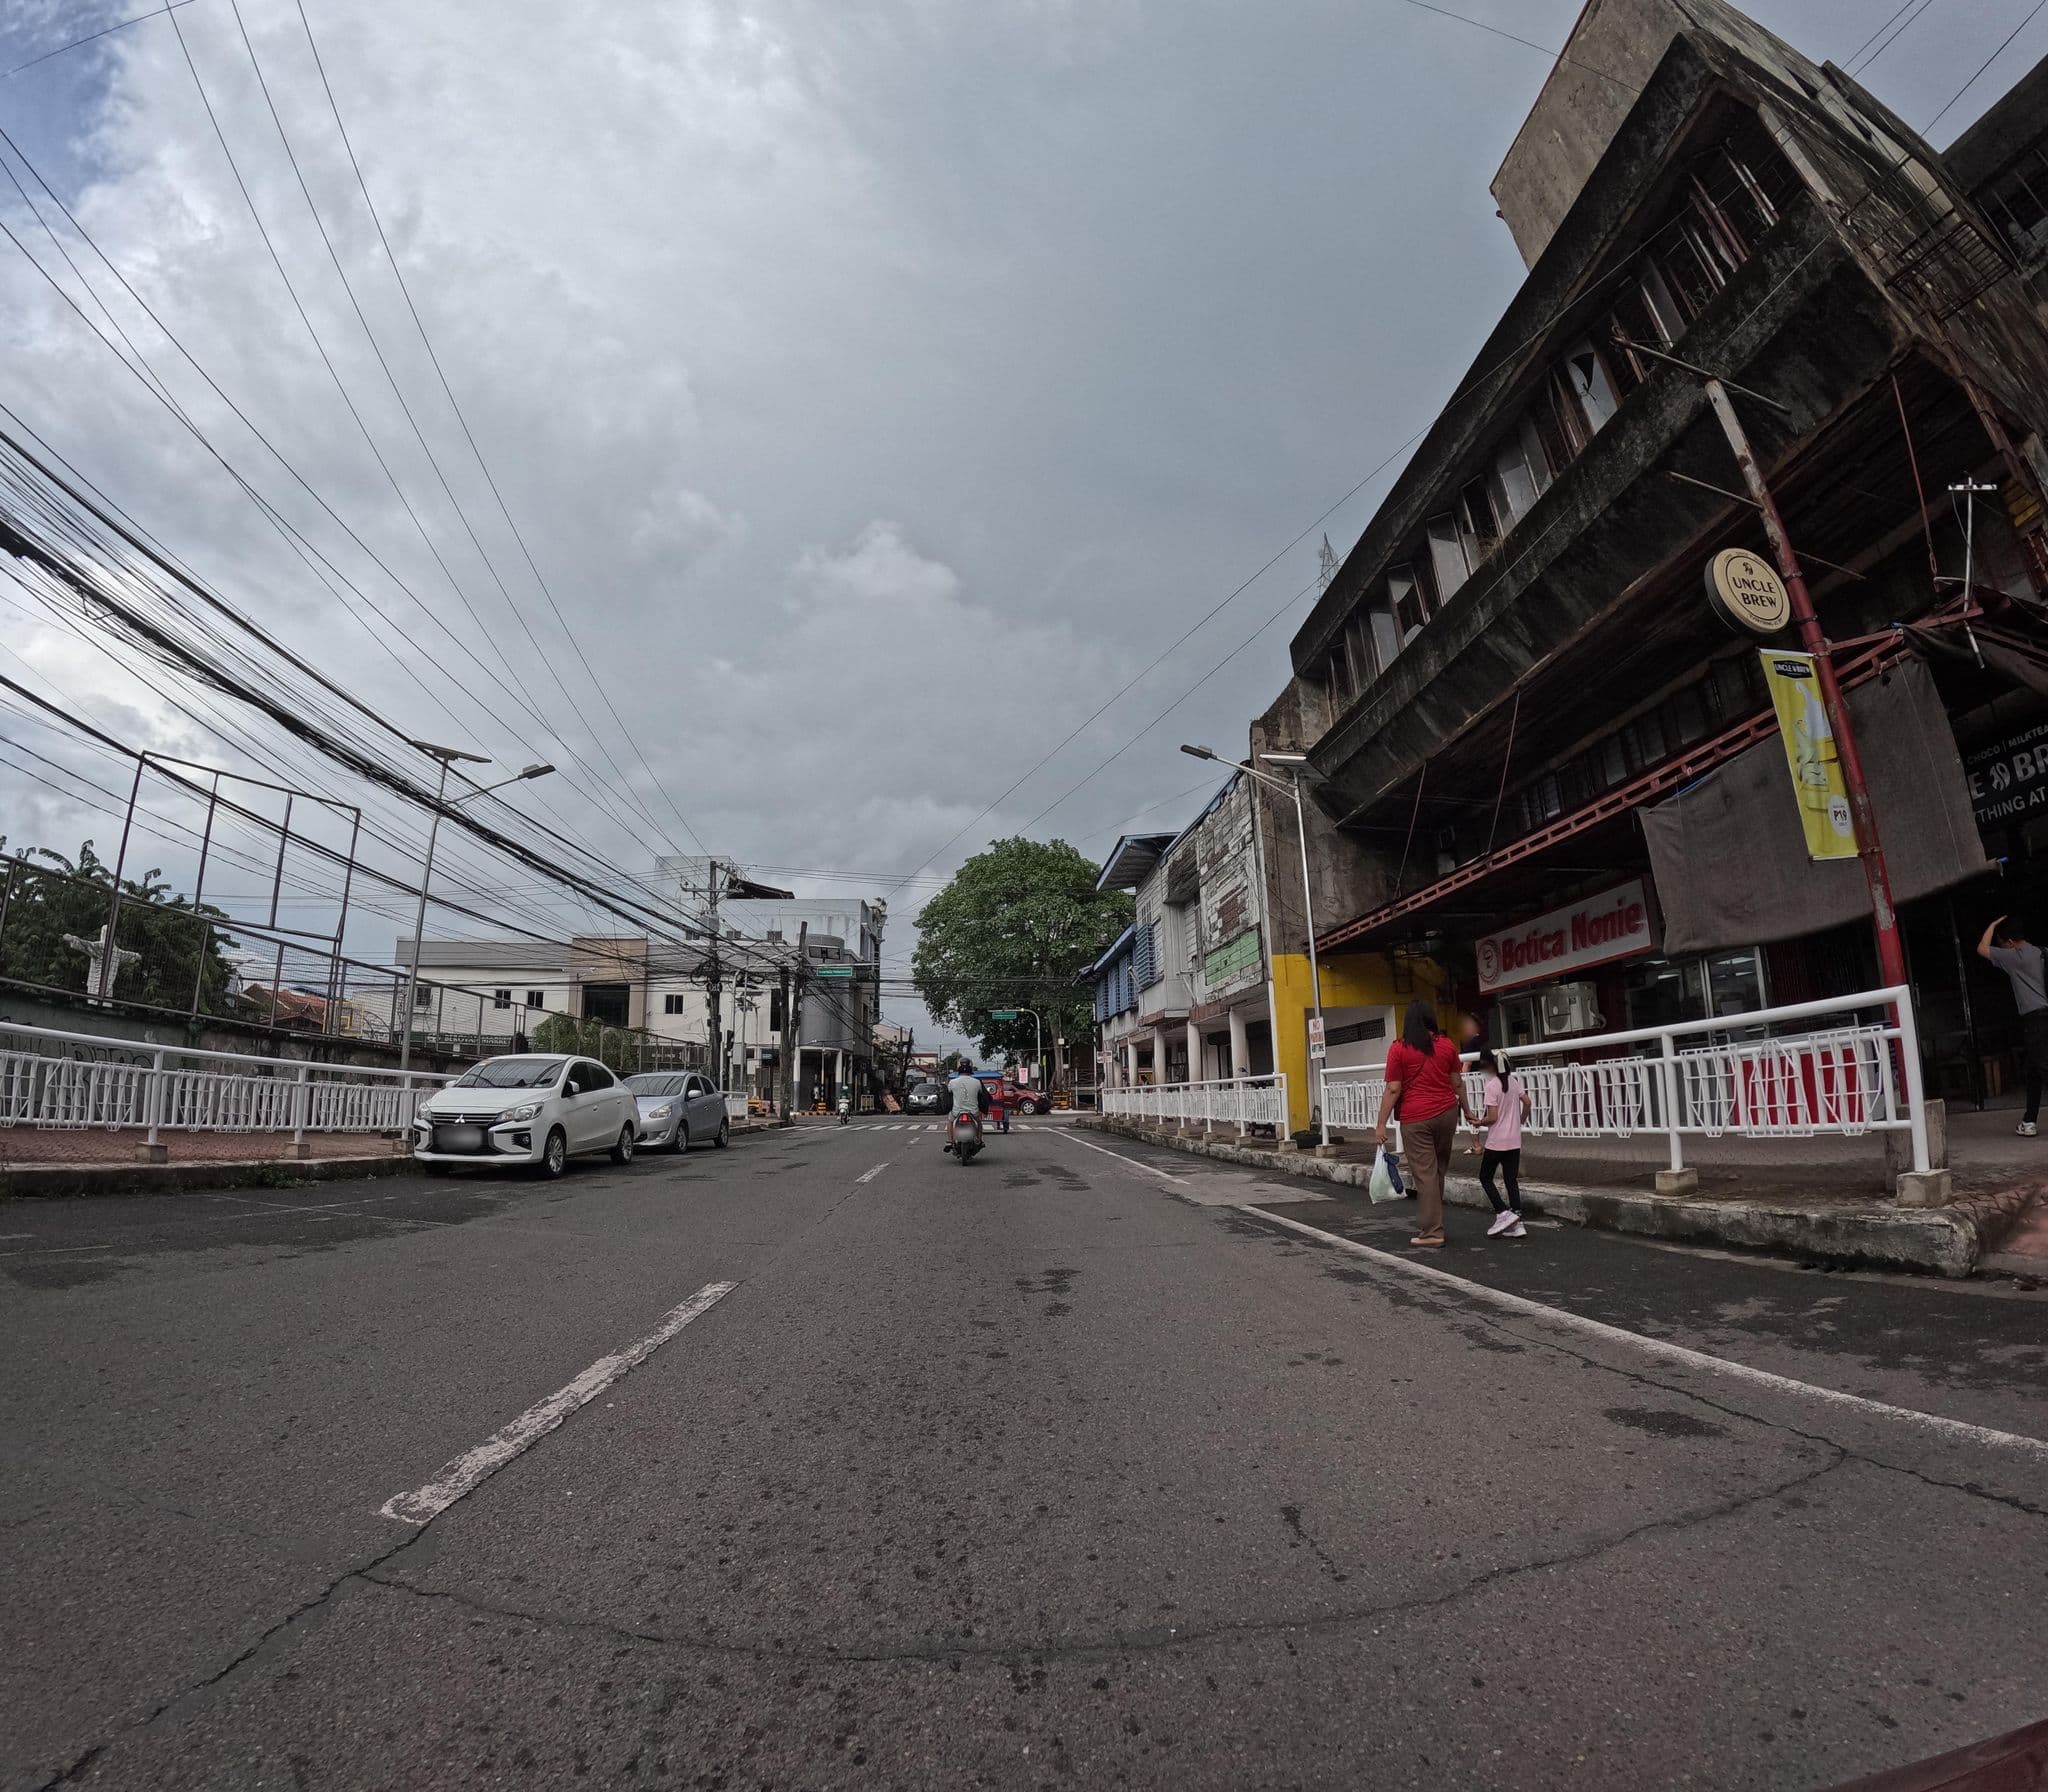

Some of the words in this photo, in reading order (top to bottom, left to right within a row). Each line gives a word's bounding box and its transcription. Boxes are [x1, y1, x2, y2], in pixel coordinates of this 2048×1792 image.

[1732, 576, 1776, 594] UNCLE
[1741, 593, 1777, 608] BREW
[1967, 744, 2001, 765] CHOCO
[2029, 786, 2047, 807] AT
[1501, 926, 1566, 972] Botica
[1571, 896, 1643, 952] Nonie
